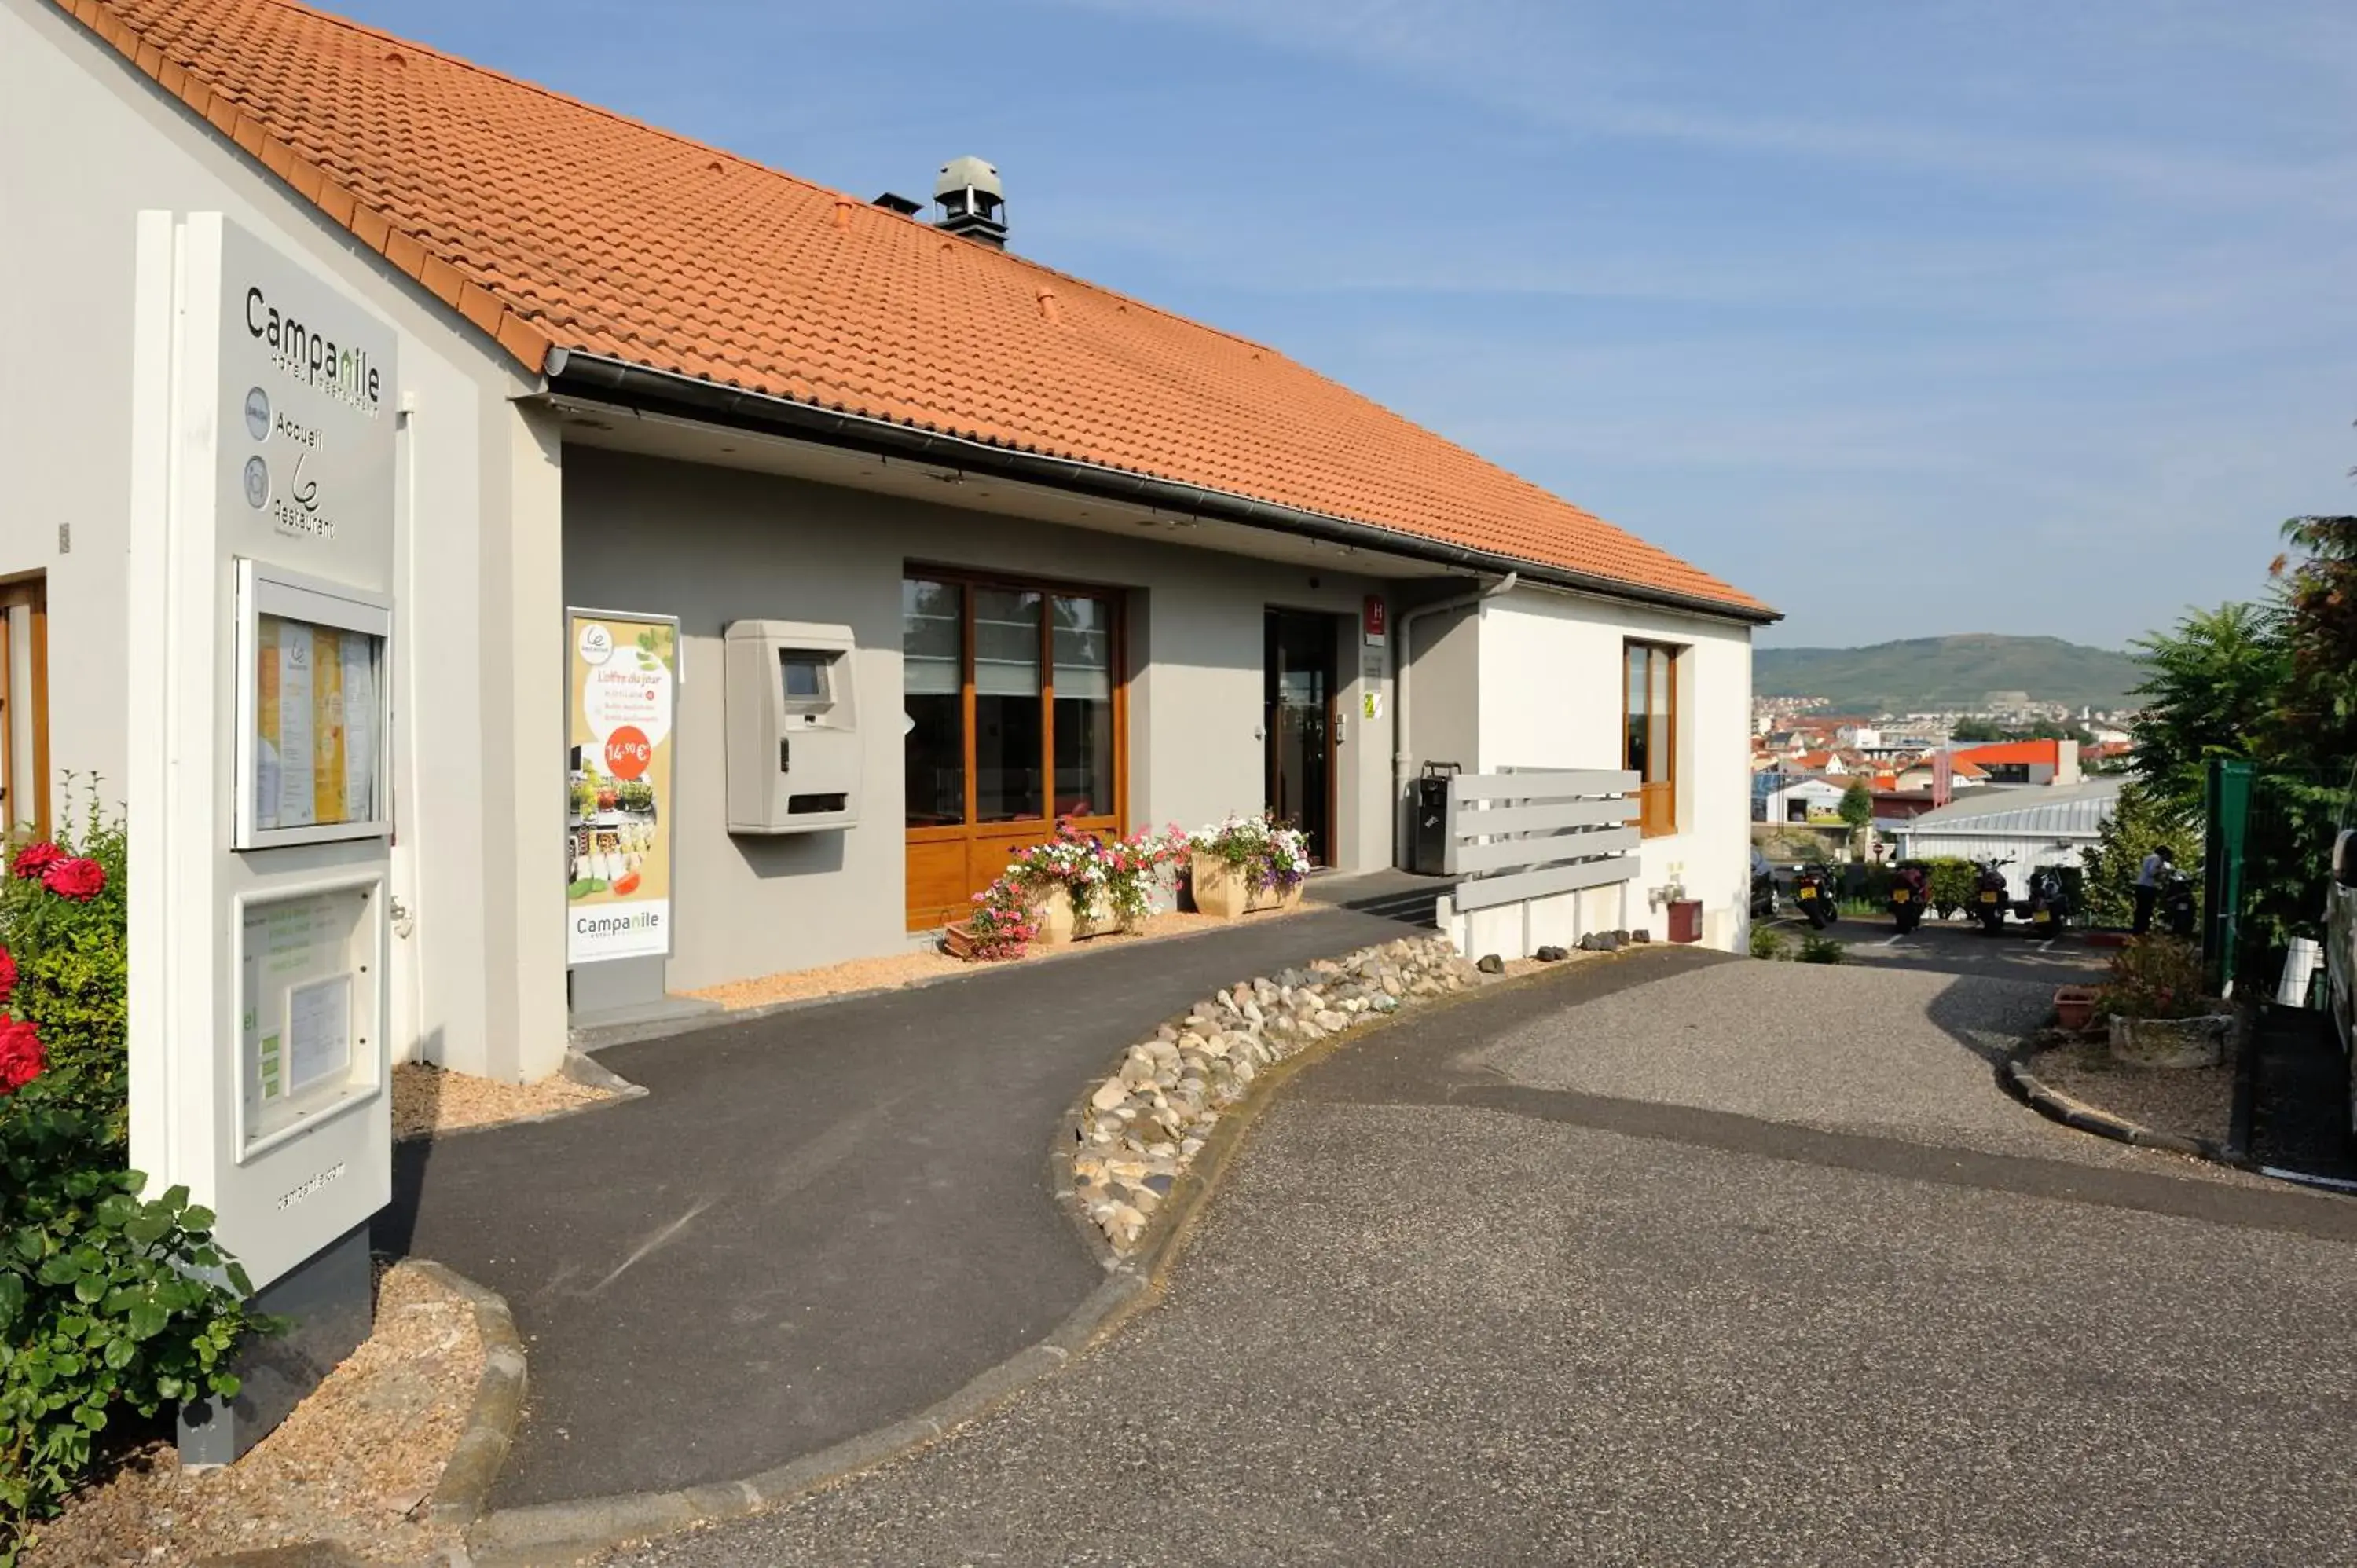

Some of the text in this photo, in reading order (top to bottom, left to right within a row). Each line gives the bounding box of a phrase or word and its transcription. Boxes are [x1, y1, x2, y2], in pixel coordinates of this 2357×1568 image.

[246, 287, 379, 402] Campanile
[277, 412, 323, 452] Accueil
[275, 499, 335, 540] Restaurant
[1374, 603, 1383, 619] H
[577, 911, 659, 936] Campanile
